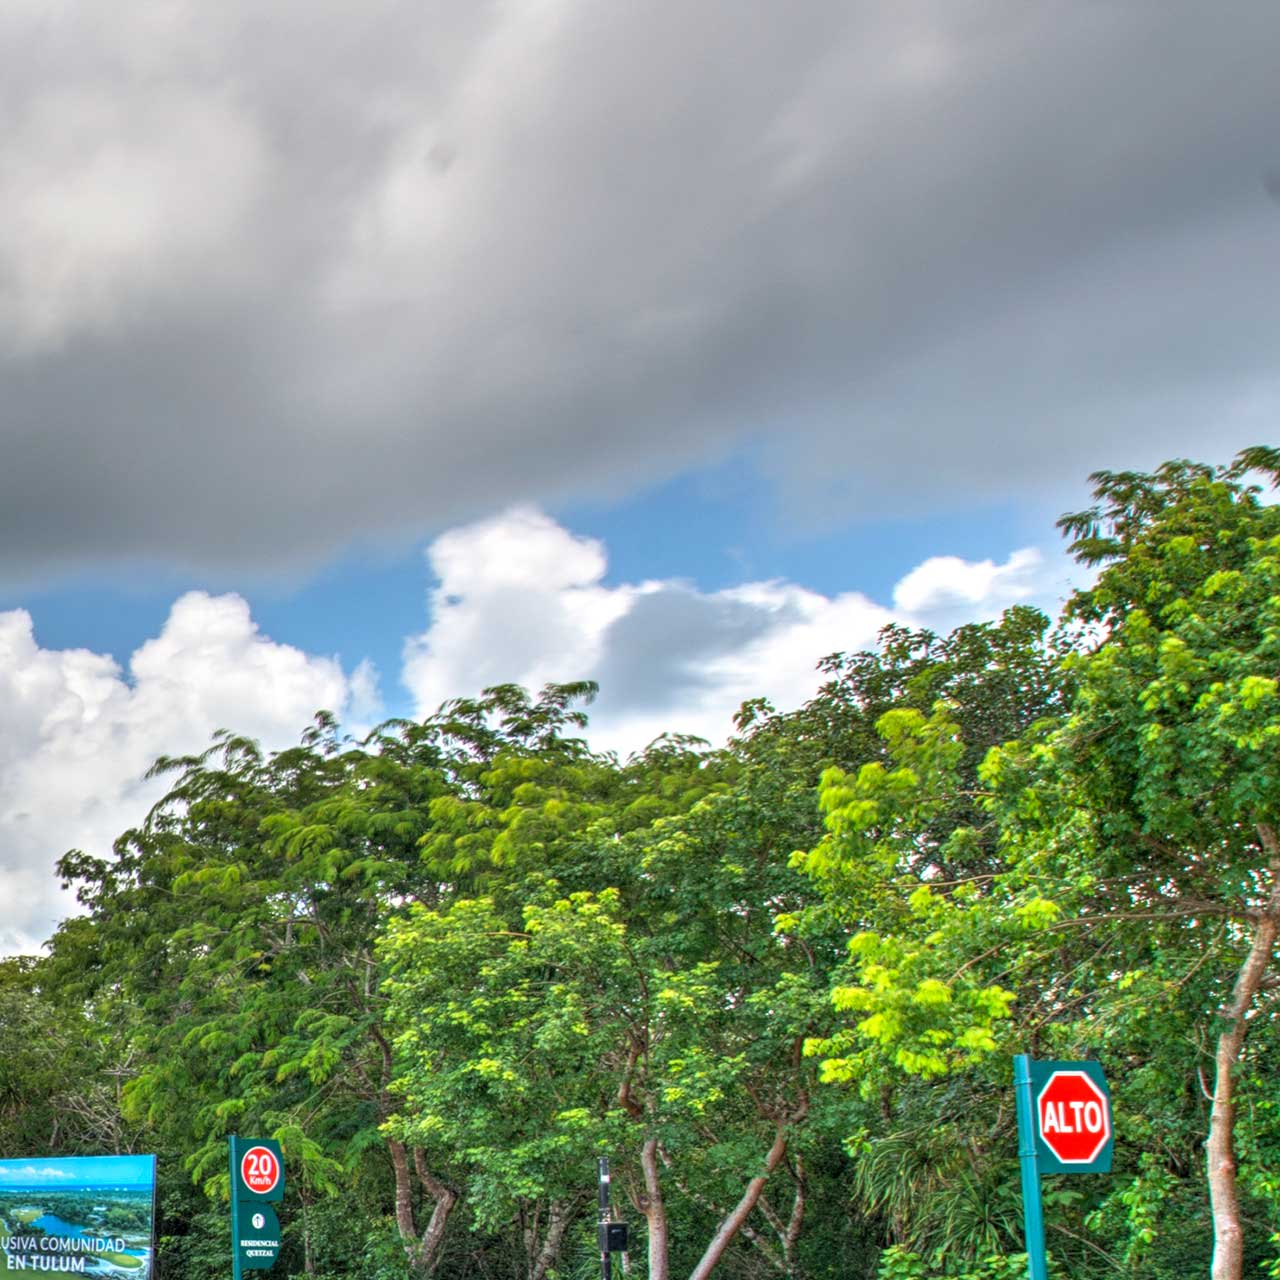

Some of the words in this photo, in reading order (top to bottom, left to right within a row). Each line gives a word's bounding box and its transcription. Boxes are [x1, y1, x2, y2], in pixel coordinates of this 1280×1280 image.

[1043, 1101, 1102, 1133] ALTO
[247, 1154, 272, 1175] 20
[250, 1175, 272, 1185] Km/h
[40, 1236, 126, 1253] COMUNIDAD
[246, 1249, 274, 1258] QUETZAL
[6, 1254, 26, 1270] EN
[30, 1255, 85, 1272] TULUM
